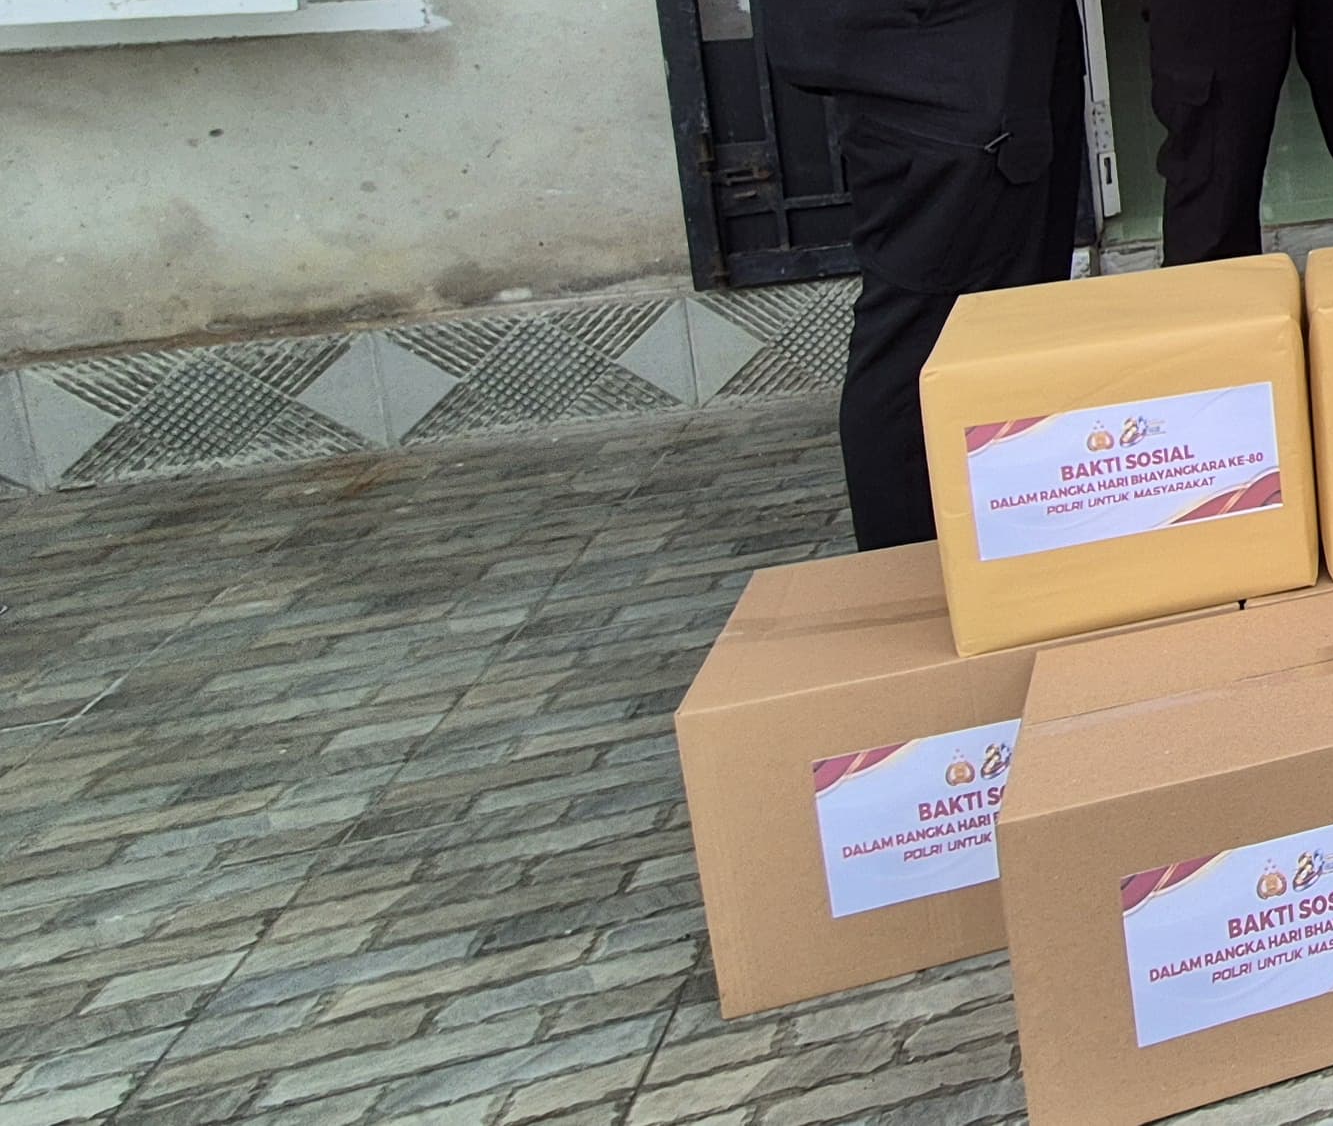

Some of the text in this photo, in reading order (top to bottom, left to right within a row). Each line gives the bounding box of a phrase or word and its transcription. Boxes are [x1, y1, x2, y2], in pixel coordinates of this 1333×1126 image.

[990, 452, 1264, 511] DALAM RANGKA HARI BHAYANGKARA KE-80
[1060, 444, 1195, 482] BAKTI SOSIAL
[1046, 476, 1216, 515] POLRI UNTUK MASYARAKAT
[918, 790, 983, 822] BAKTI
[842, 836, 894, 859] DALAM
[896, 822, 957, 845] RANGKA
[957, 813, 991, 835] HARI
[903, 832, 992, 862] POLRI UNTUK
[1227, 904, 1294, 939] BAKTI
[1149, 956, 1202, 982] DALAM
[1204, 940, 1267, 969] RANGKA
[1267, 929, 1302, 949] HARI
[1212, 962, 1252, 984] POLRI
[1257, 947, 1303, 971] UNTUK
